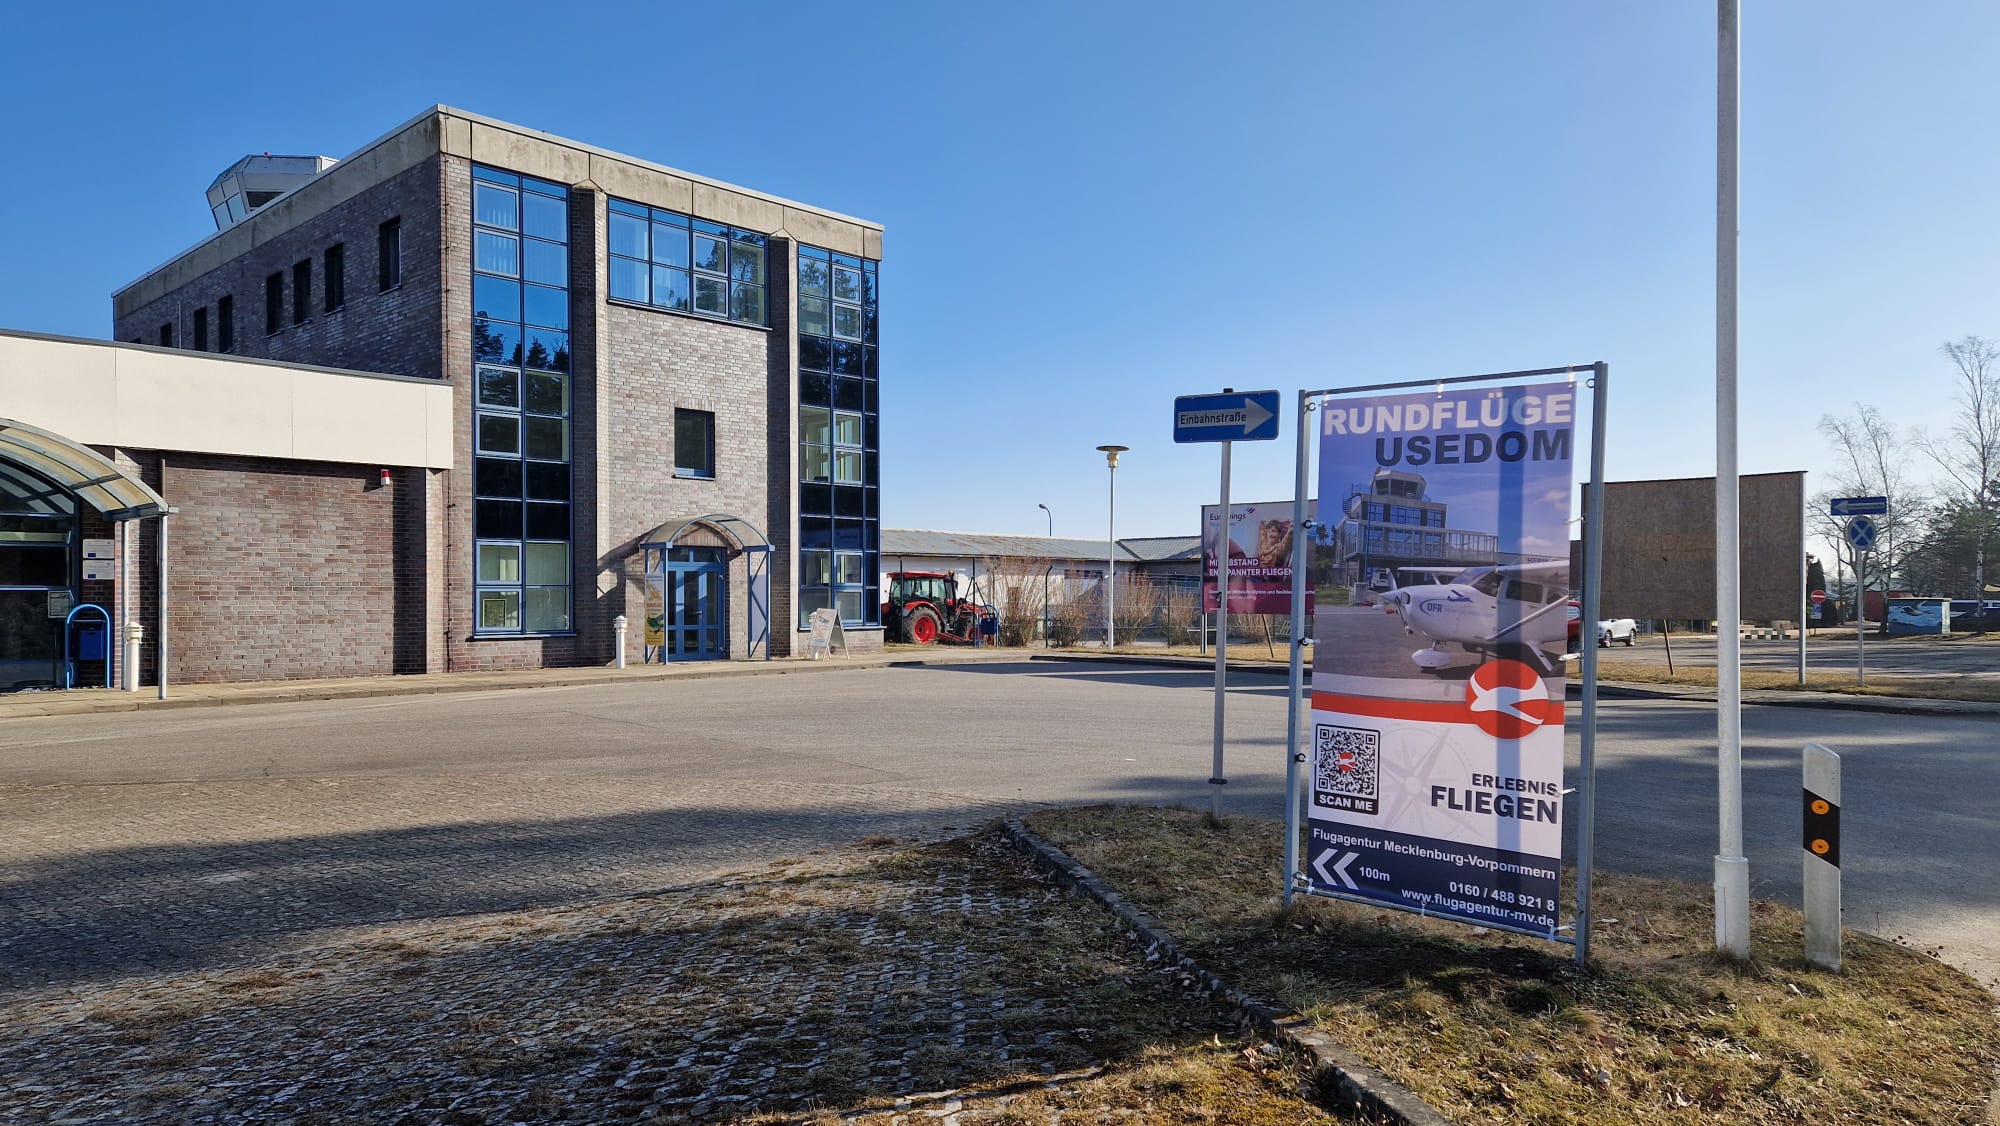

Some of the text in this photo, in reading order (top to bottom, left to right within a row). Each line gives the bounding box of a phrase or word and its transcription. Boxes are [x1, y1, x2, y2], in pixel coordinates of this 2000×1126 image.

[1180, 411, 1247, 425] Einbahnstraße
[1324, 392, 1573, 435] RUNDFLÜGE
[1375, 428, 1571, 467] USEDOM
[1209, 568, 1261, 577] ENPANNTER
[1227, 558, 1259, 566] BSTAND
[1471, 773, 1559, 798] ERLEBNIS
[1319, 794, 1374, 811] SCAN ME
[1431, 785, 1558, 825] FLIEGEN
[1313, 828, 1556, 880] Flugagentur Mecklenburg-Vorpommern
[1359, 866, 1391, 882] 100m
[1401, 888, 1556, 928] www.flugagentur-mv.de
[1450, 881, 1481, 898] 0160
[1491, 889, 1516, 904] 488
[1518, 894, 1542, 909] 921
[1547, 899, 1556, 912] 8
